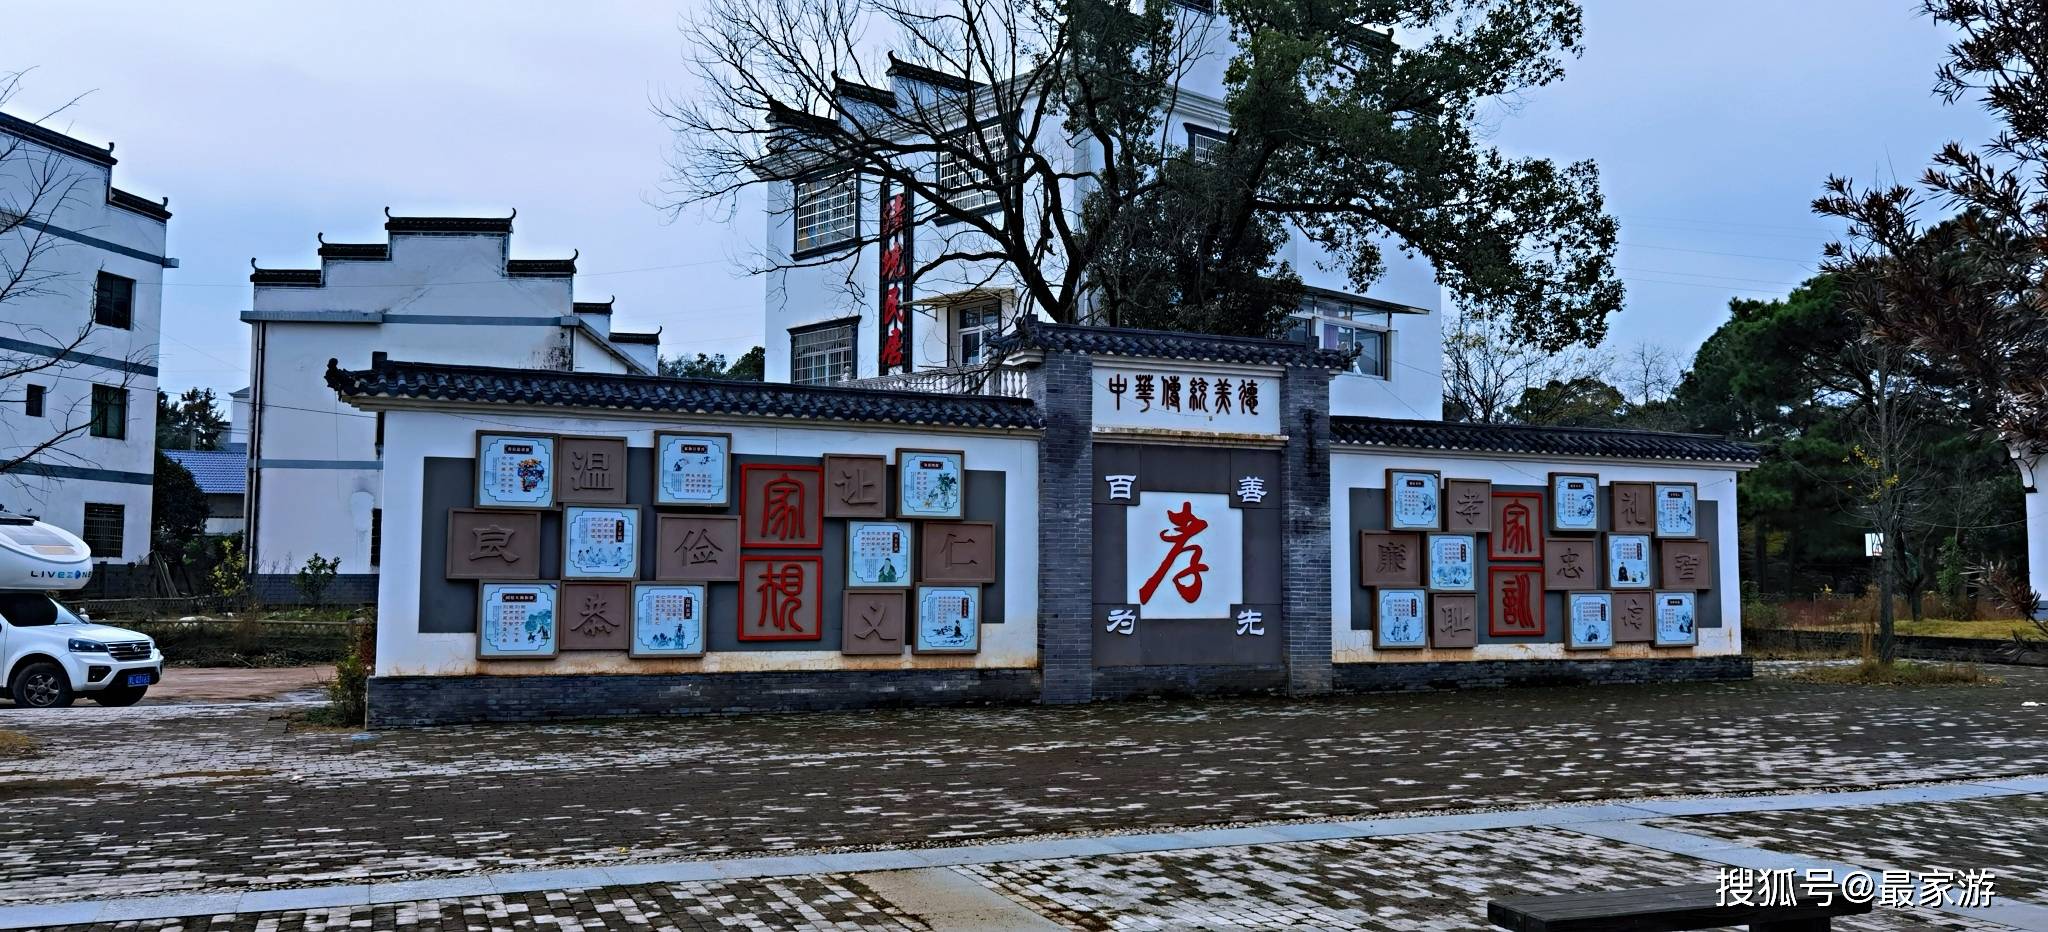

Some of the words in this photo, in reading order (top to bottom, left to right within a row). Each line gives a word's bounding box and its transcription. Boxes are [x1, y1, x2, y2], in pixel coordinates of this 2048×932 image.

[835, 468, 877, 505] 让
[1105, 474, 1137, 500] 百
[1237, 476, 1267, 503] 善
[1456, 488, 1485, 525] 孝
[1621, 491, 1646, 525] 礼
[469, 524, 520, 563] 良
[674, 527, 723, 567] 俭
[940, 532, 976, 569] 仁
[1138, 501, 1209, 606] 孝
[1376, 541, 1407, 574] 廉
[1556, 547, 1585, 581] 忠
[570, 593, 620, 638] 恭
[854, 601, 897, 640] 义
[1105, 609, 1137, 636] 为
[1236, 609, 1265, 636] 先
